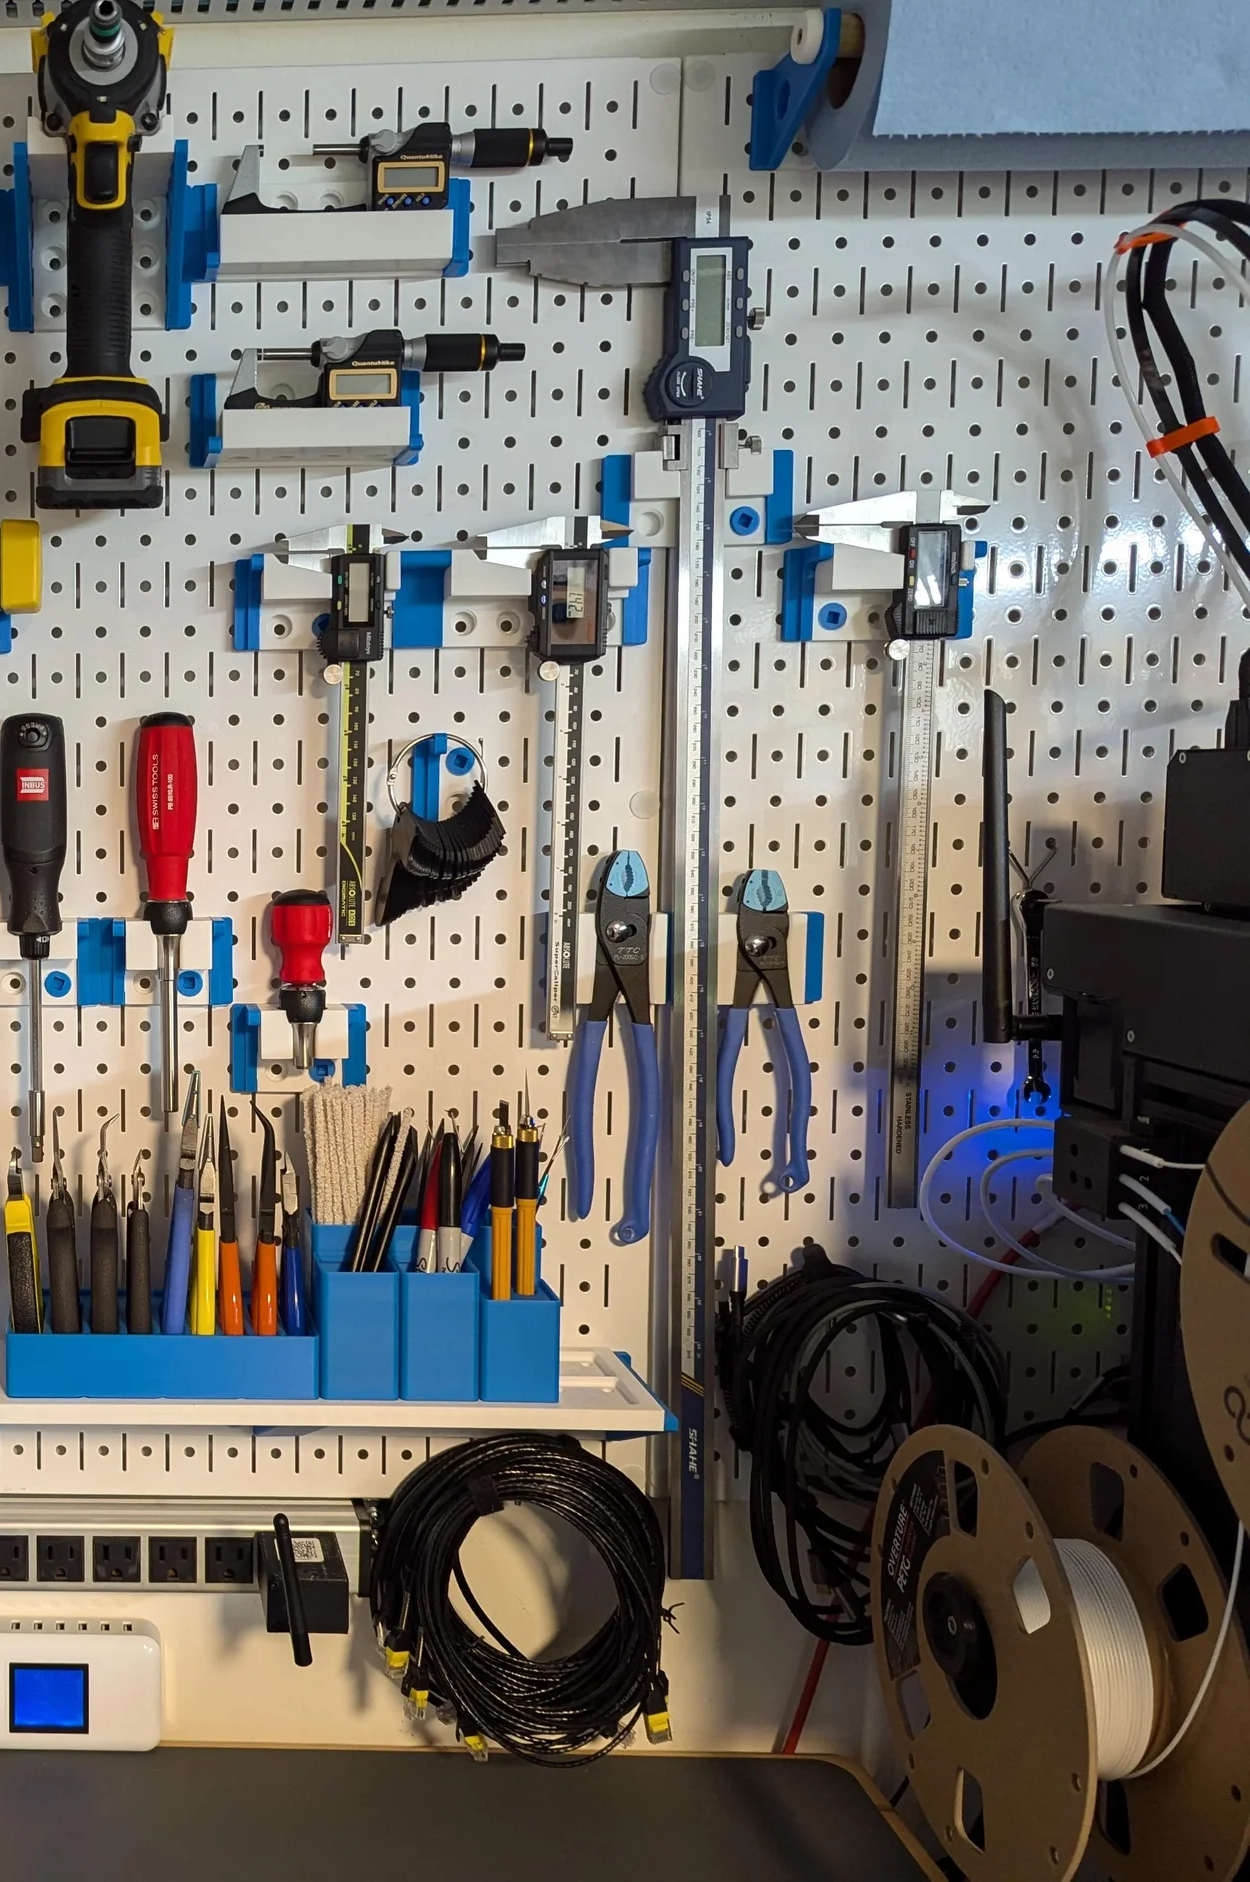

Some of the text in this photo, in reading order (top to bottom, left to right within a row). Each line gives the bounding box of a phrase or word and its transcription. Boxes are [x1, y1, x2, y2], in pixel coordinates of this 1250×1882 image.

[22, 781, 46, 789] INBUS
[562, 942, 571, 969] ABSOLUTE
[904, 1092, 912, 1130] STAINLESS
[895, 1115, 903, 1154] HARDENED
[688, 1427, 698, 1474] SHAHE
[888, 1504, 908, 1577] OVERTURE
[896, 1555, 911, 1594] PETG
